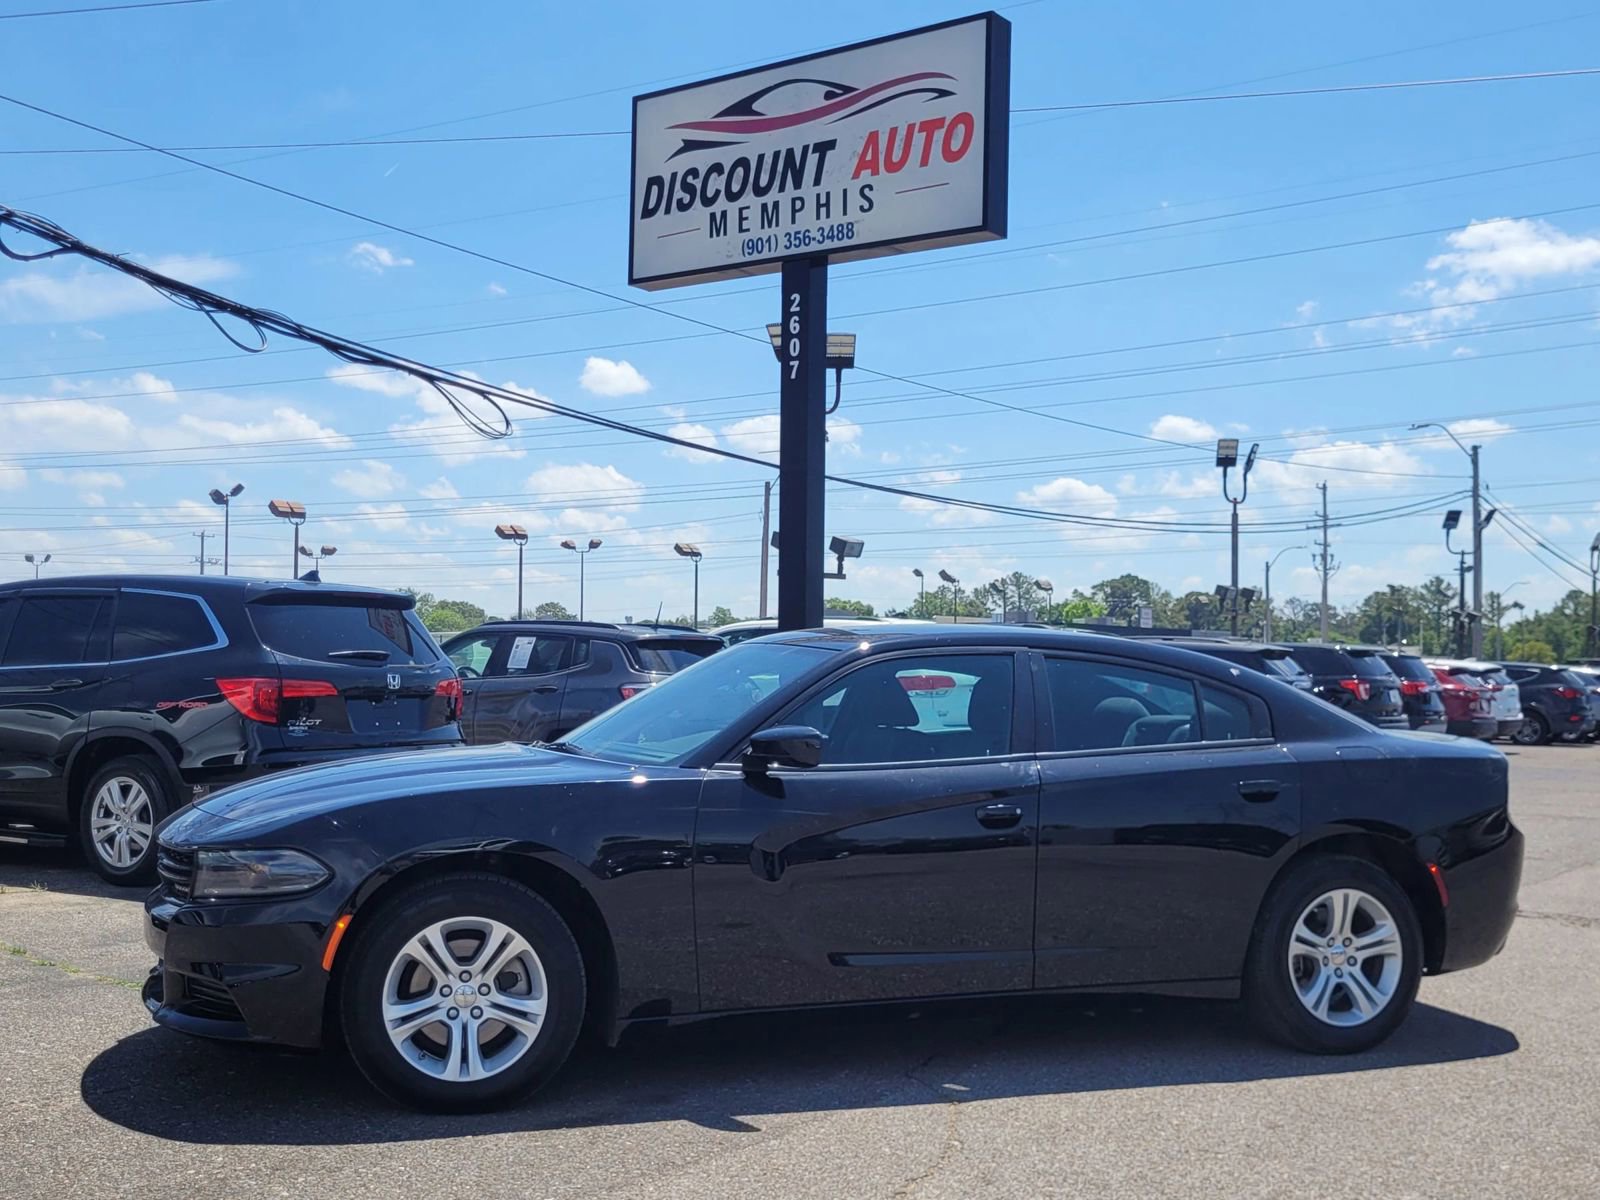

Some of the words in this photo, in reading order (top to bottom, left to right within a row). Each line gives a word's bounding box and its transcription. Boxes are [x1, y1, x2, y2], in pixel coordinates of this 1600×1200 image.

[640, 138, 838, 220] DISCOUNT
[851, 111, 975, 181] AUTO
[709, 183, 875, 239] MEMPHIS
[741, 234, 779, 258] (901)
[783, 221, 856, 251] 356-3488
[789, 293, 801, 380] 2607
[287, 717, 323, 726] PILOT
